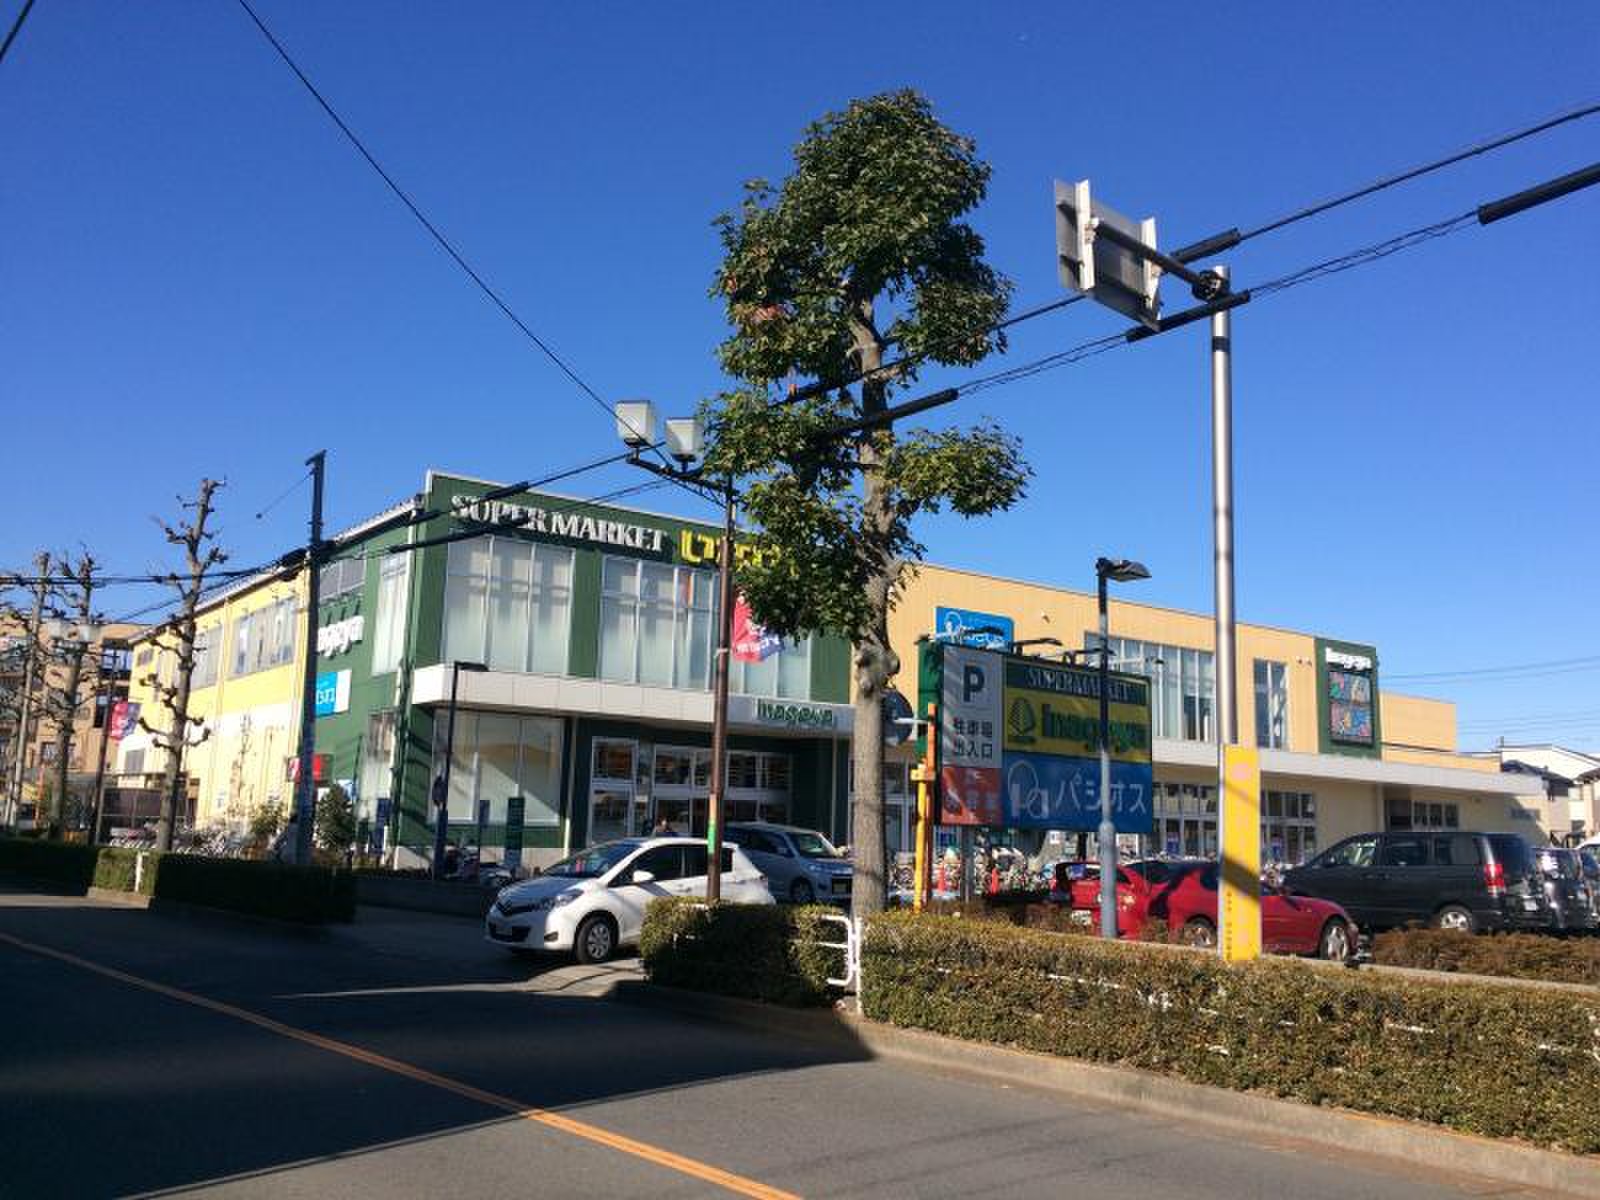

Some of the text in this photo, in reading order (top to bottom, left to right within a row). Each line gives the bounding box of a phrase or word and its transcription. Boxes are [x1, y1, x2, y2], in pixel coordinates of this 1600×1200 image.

[449, 494, 669, 552] SUPER MARKET
[963, 664, 985, 703] P
[1055, 768, 1147, 815] パシオス
